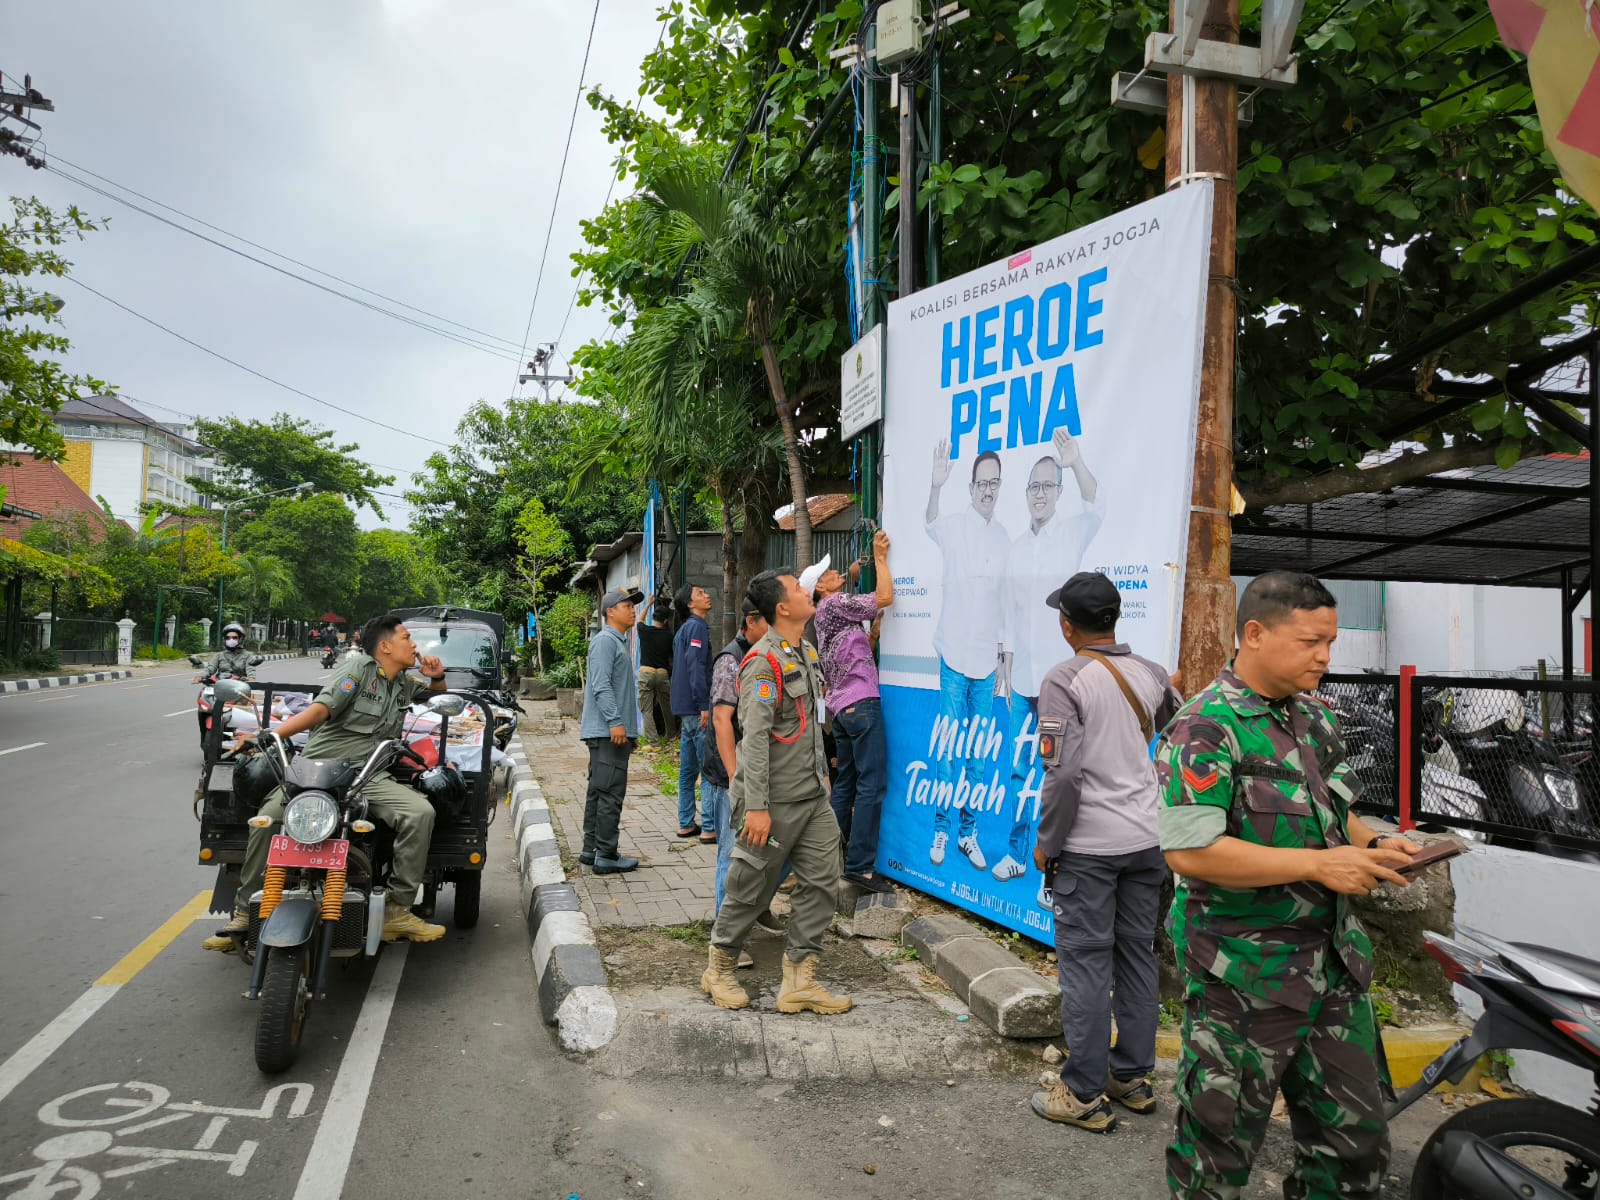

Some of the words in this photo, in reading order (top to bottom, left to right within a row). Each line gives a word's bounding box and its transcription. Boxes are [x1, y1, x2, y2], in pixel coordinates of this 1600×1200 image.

[910, 296, 958, 321] KOALISI
[963, 268, 1030, 302] BERSAMA
[1035, 242, 1097, 276] RAKYAT
[1102, 217, 1161, 252] JOGJA
[941, 266, 1107, 388] HEROE
[950, 363, 1082, 460] PENA
[893, 576, 915, 585] HEROE
[1113, 564, 1149, 576] WIDYA
[1119, 611, 1147, 619] LIKOTA
[1123, 601, 1147, 609] WAKIL
[928, 713, 1003, 762] Milih
[905, 760, 1006, 815] Tambah
[273, 838, 289, 851] AB
[951, 881, 979, 904] #JOGJA
[981, 891, 1004, 912] UNTUK
[1005, 901, 1021, 920] KITA
[1023, 909, 1051, 933] JOGJA
